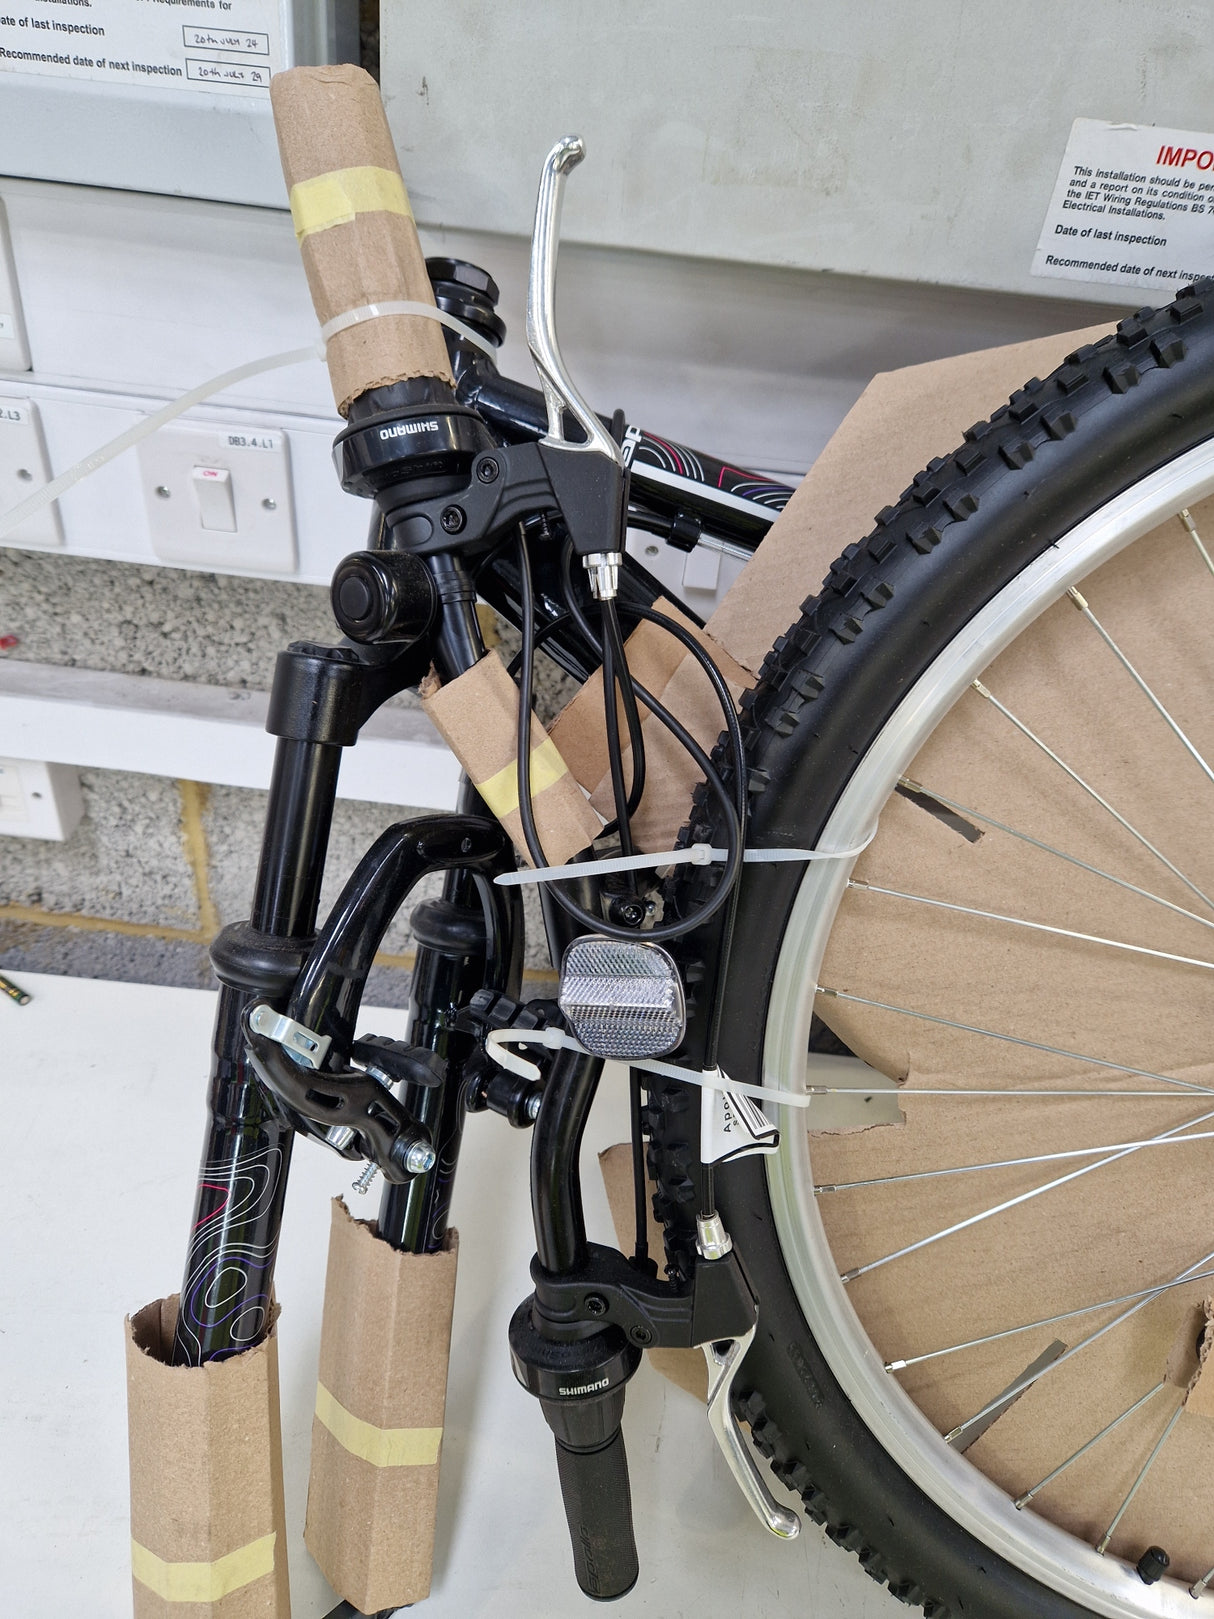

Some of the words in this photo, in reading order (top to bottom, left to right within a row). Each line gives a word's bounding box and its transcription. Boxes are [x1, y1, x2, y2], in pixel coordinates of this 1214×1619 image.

[18, 17, 29, 28] of
[31, 18, 51, 30] last
[52, 20, 105, 36] inspection
[246, 38, 259, 48] 24
[0, 47, 71, 65] Recommended
[73, 55, 94, 68] date
[96, 58, 107, 68] of
[109, 61, 130, 71] next
[132, 61, 183, 76] inspection
[251, 71, 263, 82] 29
[1156, 145, 1214, 171] IMPO
[1074, 166, 1093, 177] This
[1096, 168, 1146, 183] installation
[1149, 176, 1181, 187] should
[1183, 179, 1195, 189] be
[1067, 189, 1081, 199] the
[1085, 191, 1101, 201] IET
[1103, 193, 1131, 206] Wiring
[1134, 197, 1188, 212] Regulations
[1191, 203, 1206, 214] BS
[1069, 178, 1087, 188] and
[1090, 181, 1097, 189] a
[1099, 183, 1128, 192] report
[1131, 186, 1143, 195] on
[1146, 186, 1158, 196] its
[1162, 188, 1204, 203] condition
[1062, 199, 1106, 213] Electrical
[1108, 205, 1166, 220] Installations.
[1054, 224, 1078, 236] Date
[1080, 227, 1093, 238] of
[1093, 229, 1113, 240] last
[1114, 231, 1167, 246] inspection
[1045, 255, 1119, 272] Recommended
[1120, 263, 1141, 275] date
[1143, 266, 1155, 276] of
[1155, 268, 1178, 279] next
[379, 421, 439, 440] SHIMANO
[558, 1377, 610, 1396] SHIMANO
